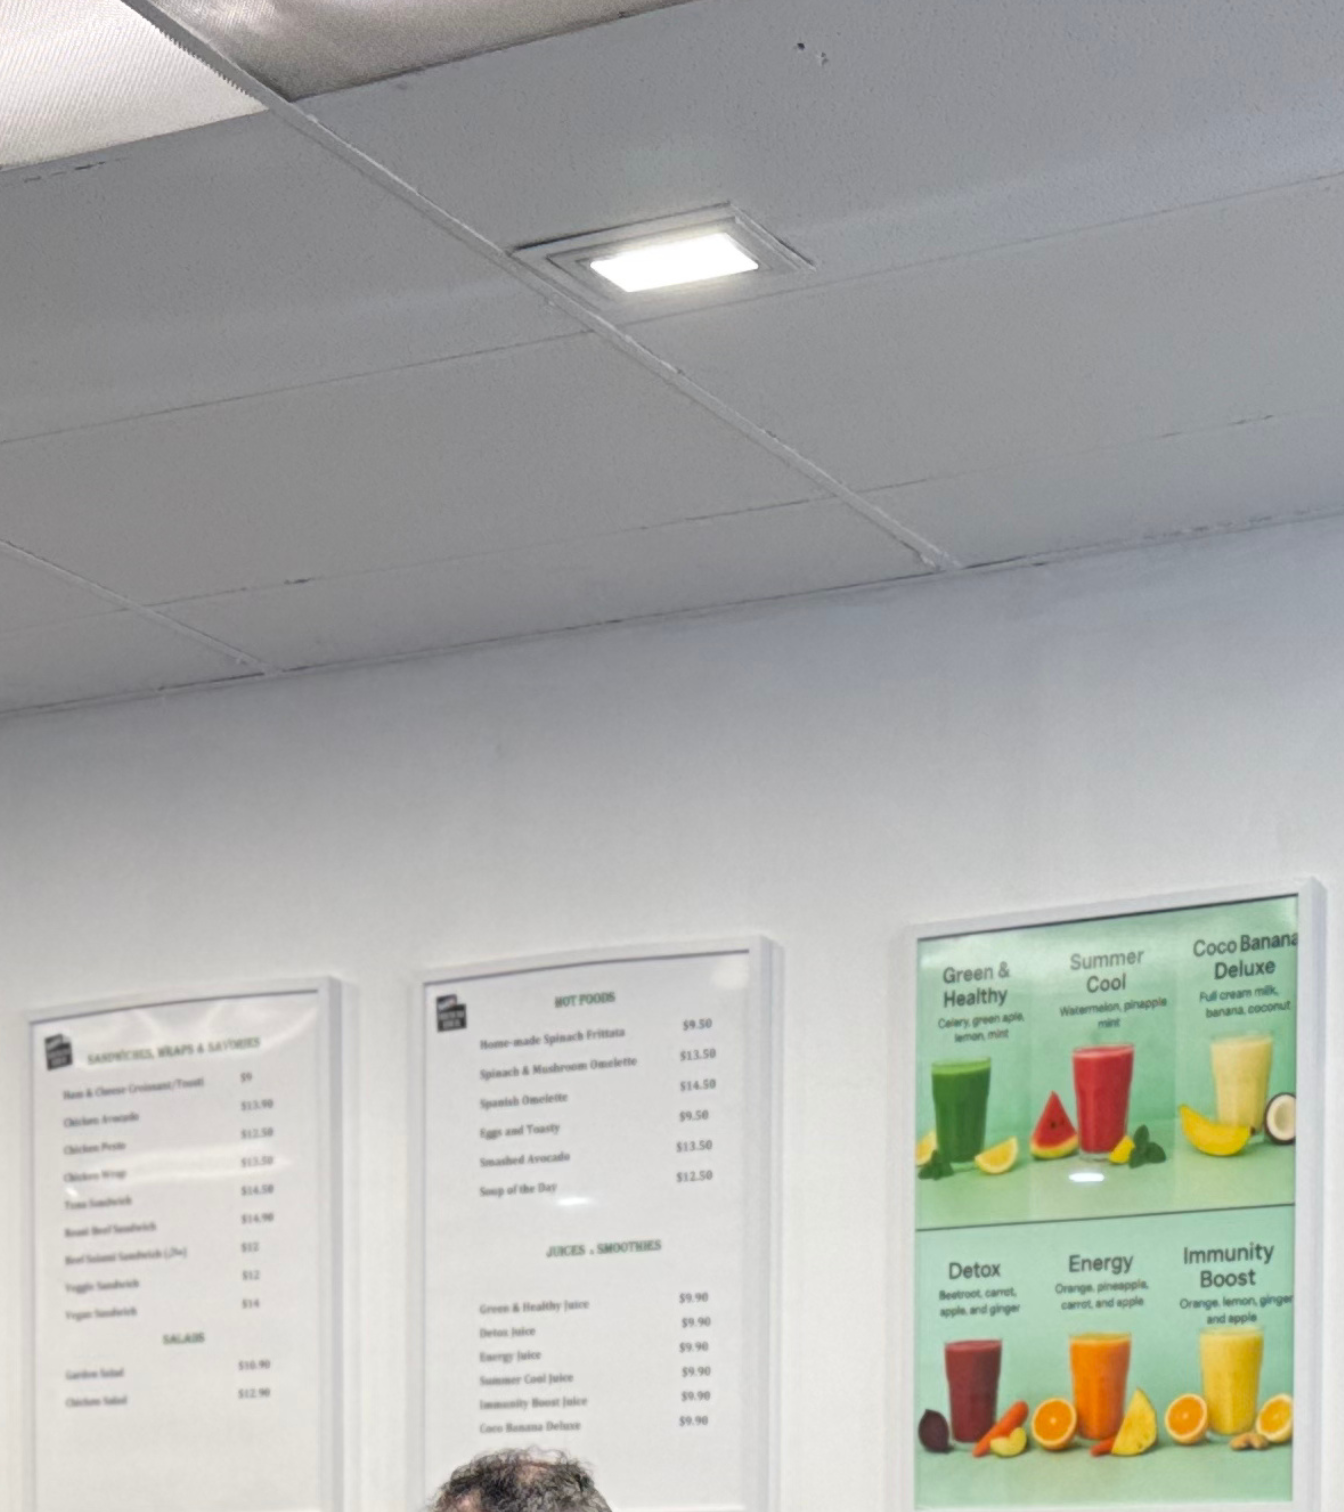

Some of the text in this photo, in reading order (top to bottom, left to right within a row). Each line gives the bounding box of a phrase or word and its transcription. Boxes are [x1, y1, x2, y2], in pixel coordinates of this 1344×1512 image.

[1193, 939, 1236, 958] Coco
[1070, 949, 1144, 971] Summer
[1214, 959, 1276, 981] Deluxe
[943, 961, 1010, 985] Green &
[1087, 974, 1126, 994] Cool
[943, 987, 1008, 1010] Healthy
[1183, 1242, 1275, 1265] Immunity
[948, 1261, 1000, 1280] Detox
[1069, 1254, 1134, 1276] Energy
[1201, 1269, 1256, 1288] Boost
